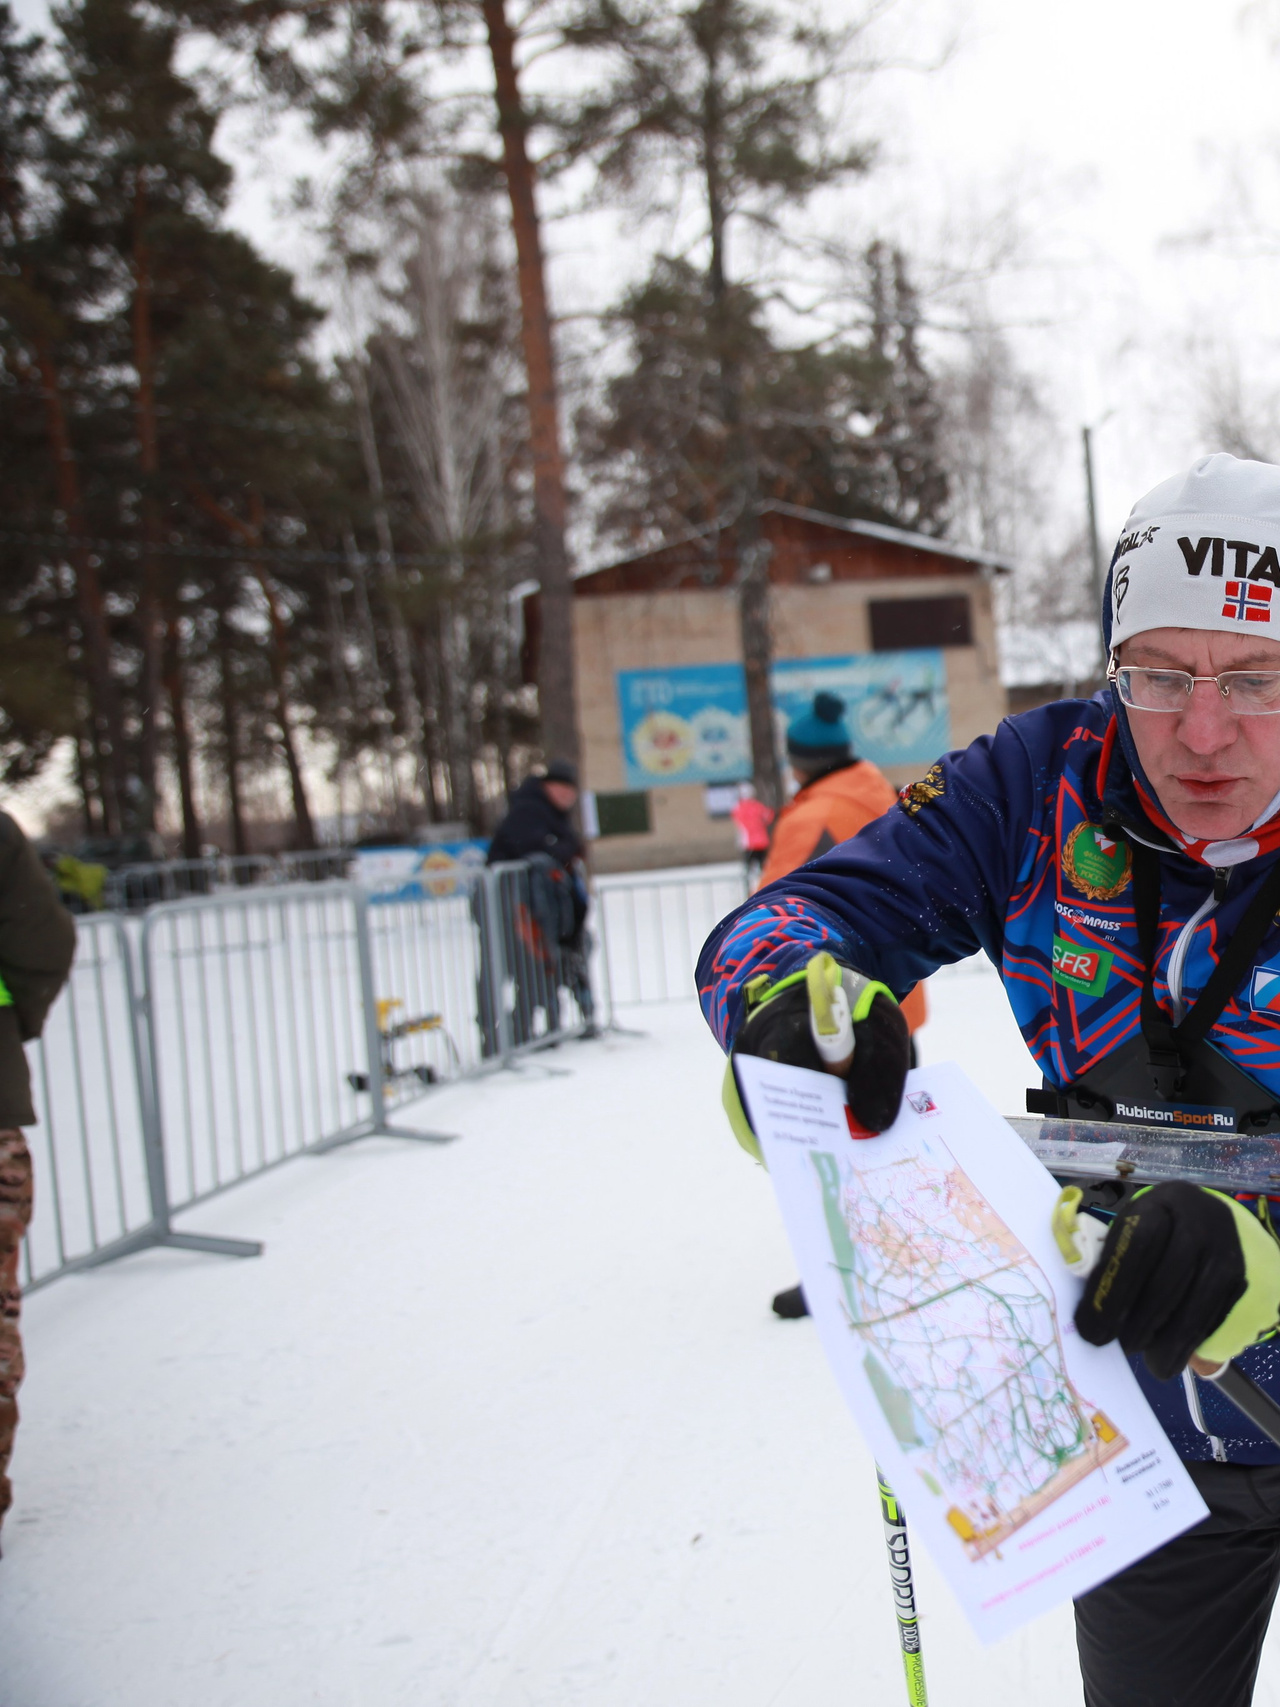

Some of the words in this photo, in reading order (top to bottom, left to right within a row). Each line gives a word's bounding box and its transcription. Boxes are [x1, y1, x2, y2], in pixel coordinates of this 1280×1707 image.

[1053, 945, 1092, 977] SFR
[1115, 1102, 1235, 1127] RubiconSportRu
[902, 1623, 920, 1651] 100%
